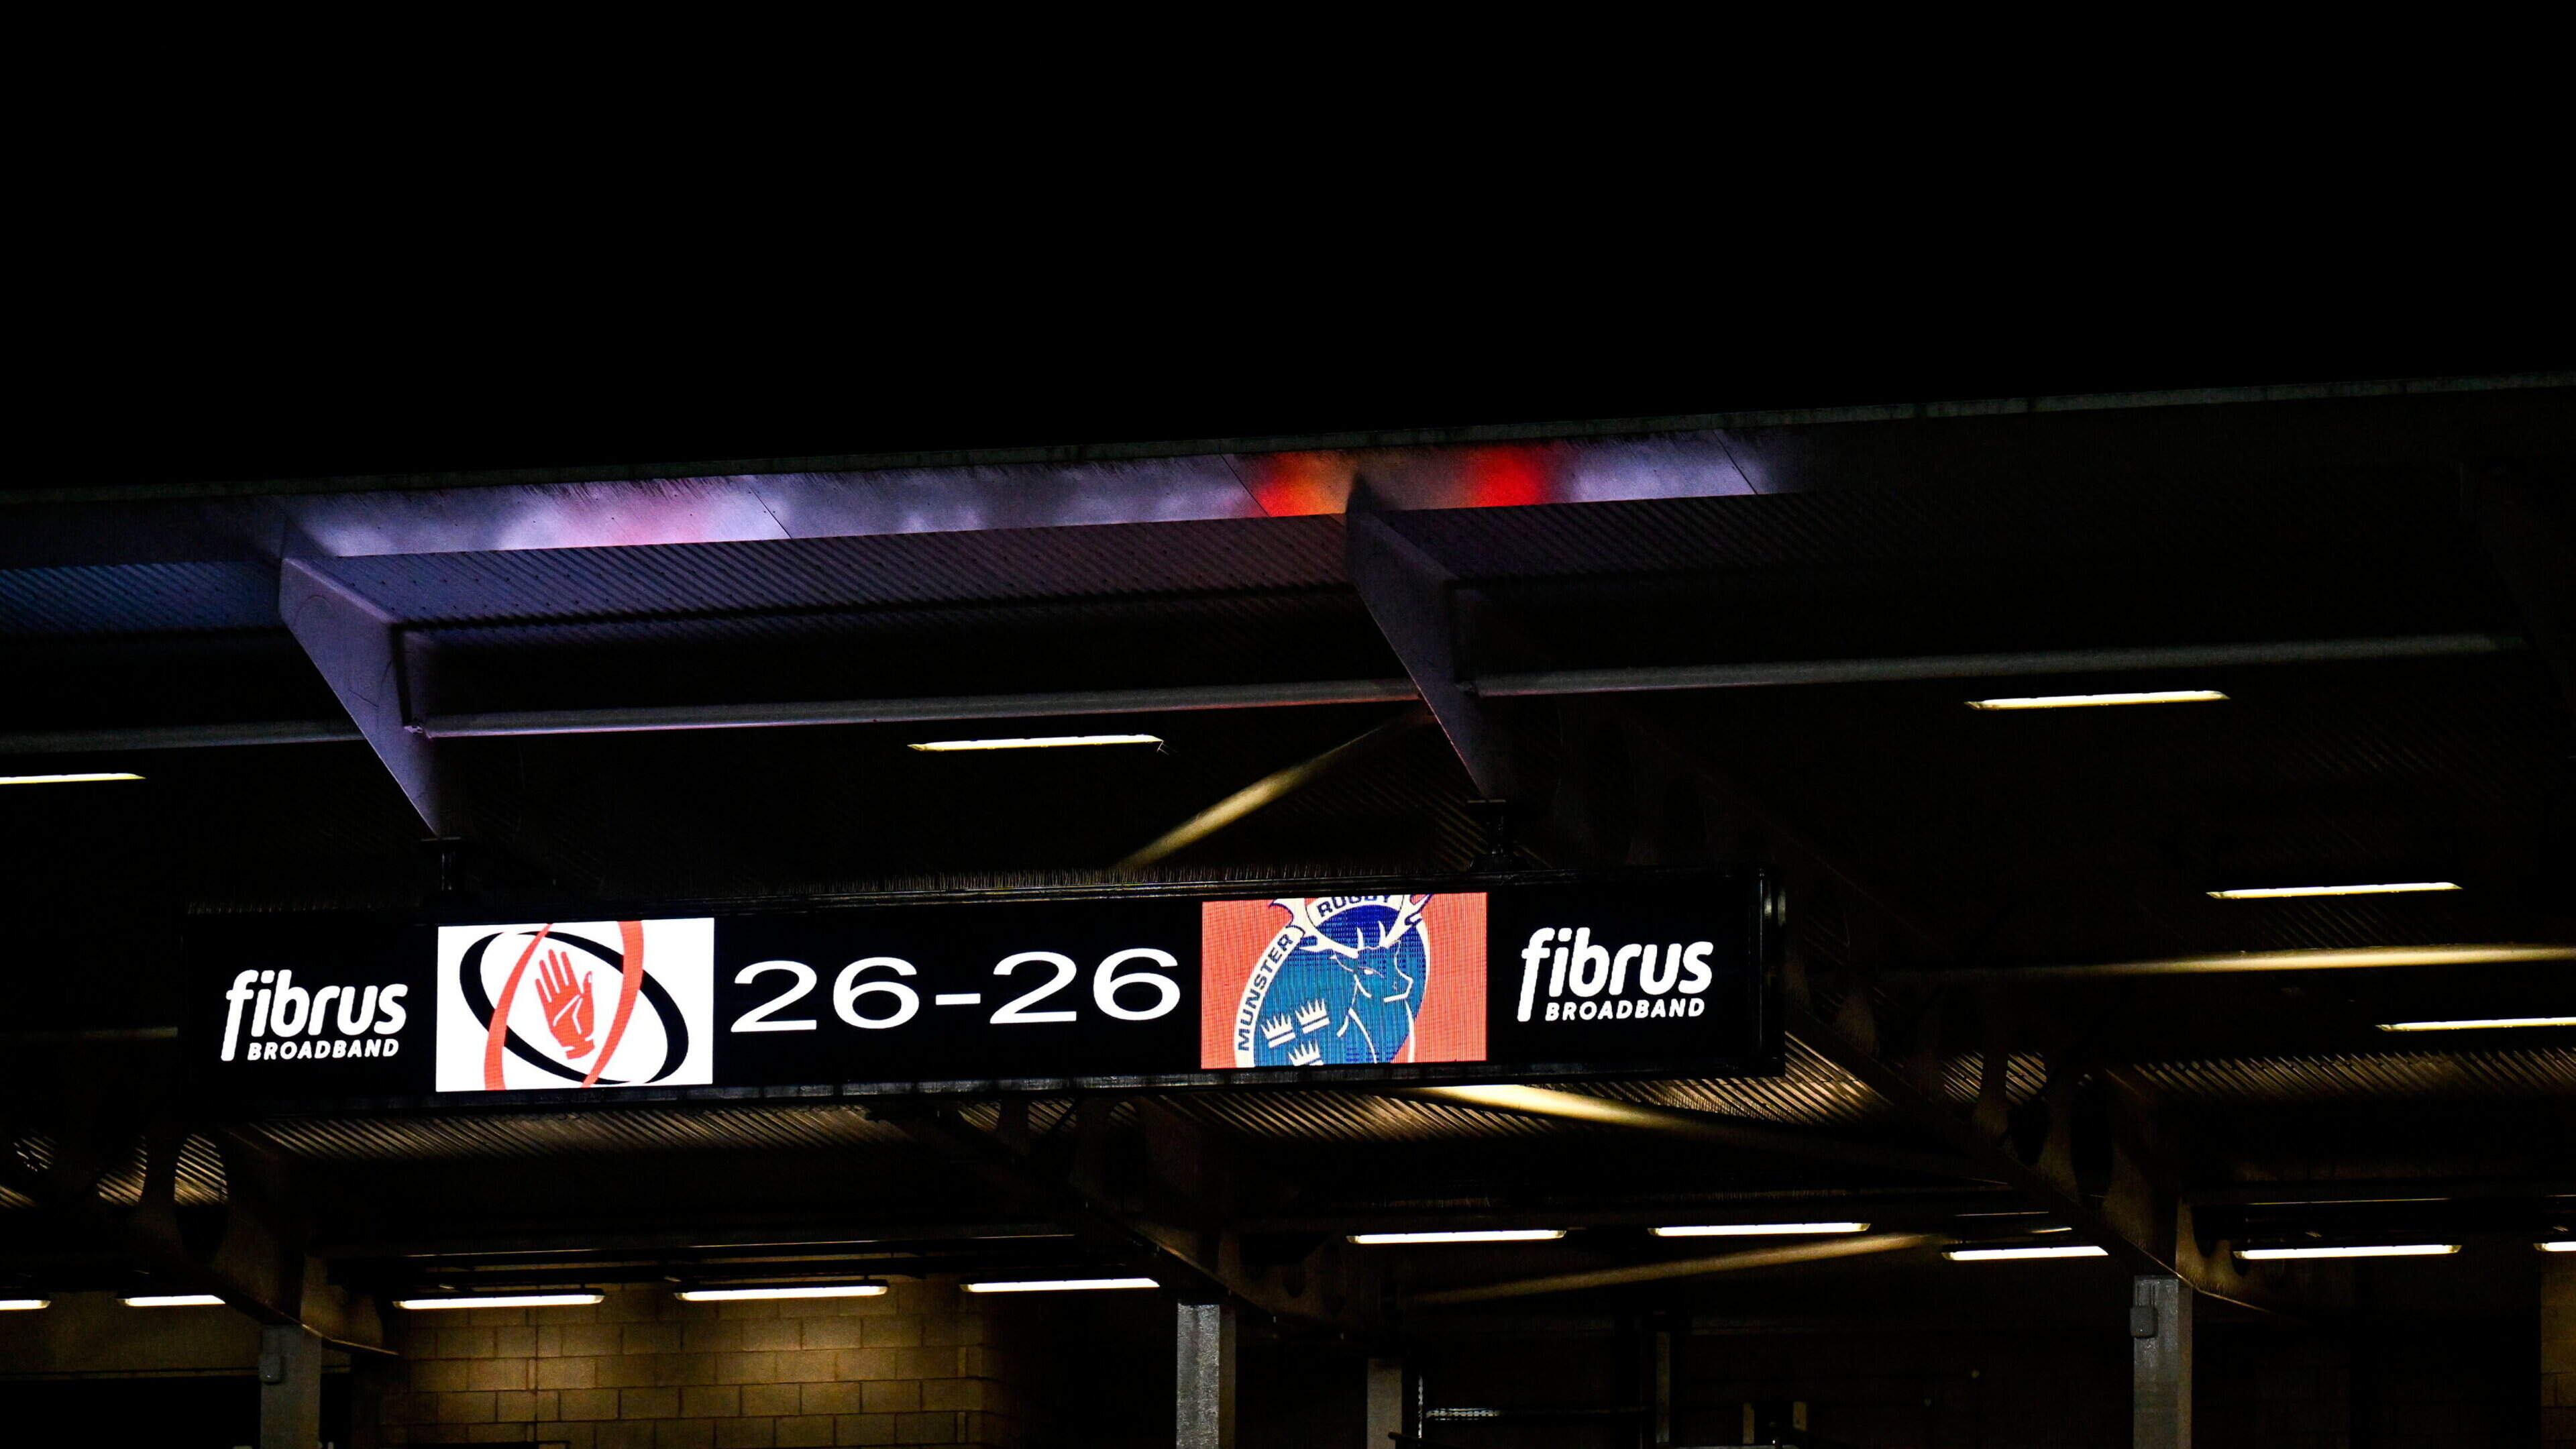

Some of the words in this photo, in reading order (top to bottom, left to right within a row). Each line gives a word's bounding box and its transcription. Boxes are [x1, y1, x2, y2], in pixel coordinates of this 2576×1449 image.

[221, 969, 409, 1062] fibrus
[730, 948, 1181, 1033] 26-26
[1238, 933, 1293, 1051] MUNSTER
[1517, 927, 1714, 1022] fibrus
[1545, 998, 1705, 1022] BROADBAND
[247, 1038, 399, 1061] BROADBAND
